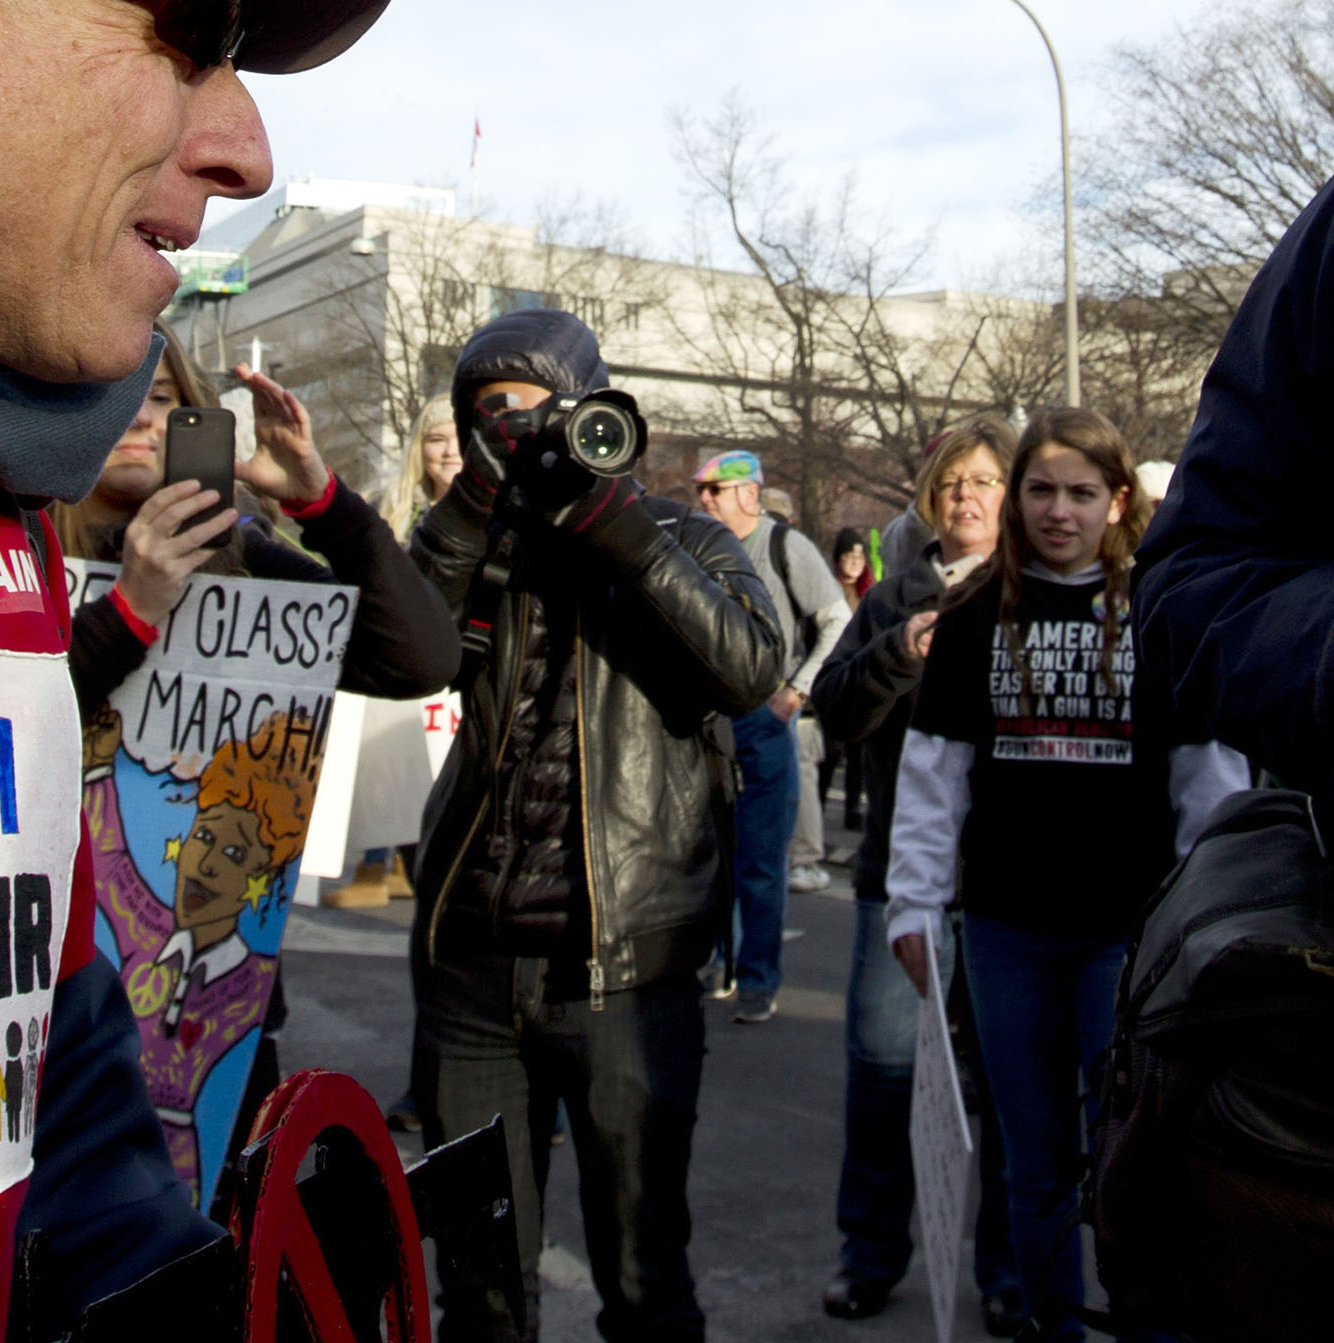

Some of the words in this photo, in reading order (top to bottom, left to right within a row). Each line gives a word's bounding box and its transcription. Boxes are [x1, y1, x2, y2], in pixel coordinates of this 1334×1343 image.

[1026, 621, 1134, 651] AMERIA
[1030, 650, 1076, 670] ONLY
[1082, 650, 1135, 673] THNG
[989, 671, 1056, 695] EASER
[1064, 672, 1088, 696] TO
[1037, 698, 1048, 717] A
[1054, 697, 1090, 718] GUN
[1097, 699, 1115, 719] IS
[1121, 700, 1131, 721] A
[137, 670, 334, 780] MARCH!
